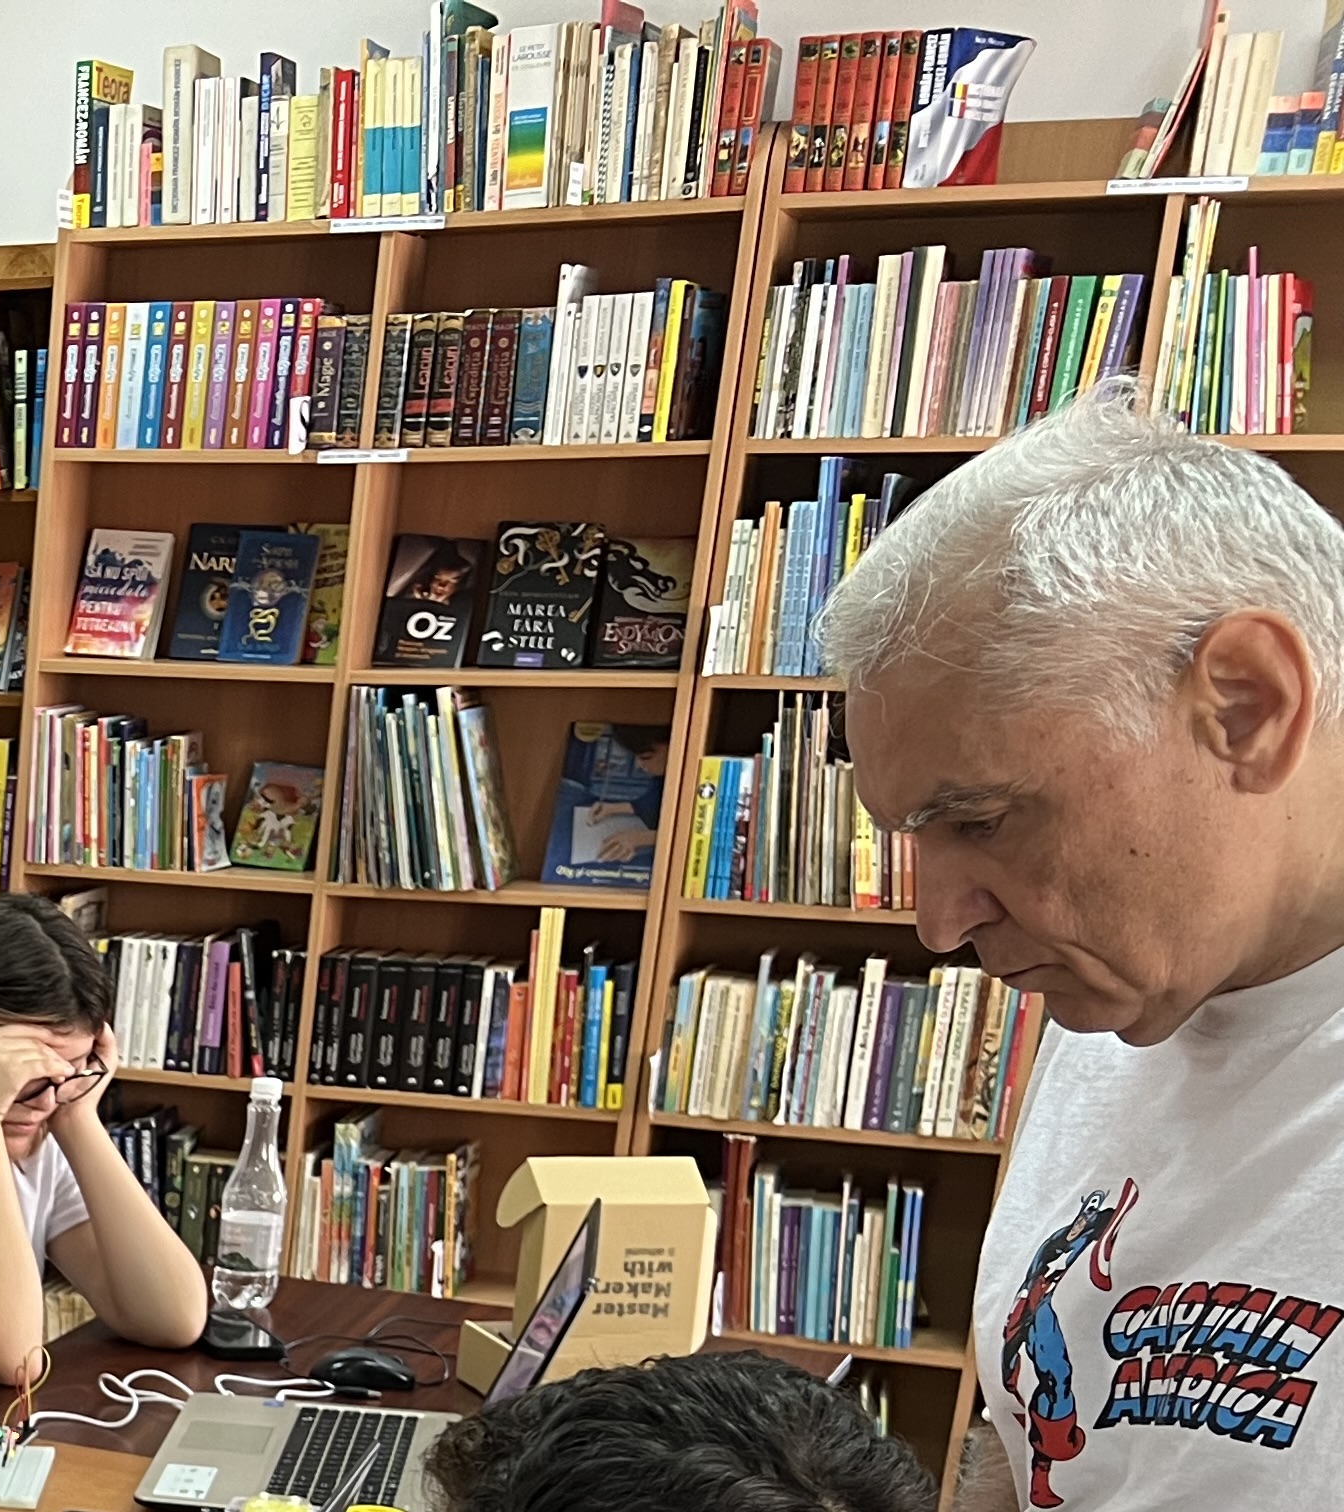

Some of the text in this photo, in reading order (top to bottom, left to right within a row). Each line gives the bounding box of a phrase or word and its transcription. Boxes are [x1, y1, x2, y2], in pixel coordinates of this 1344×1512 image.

[95, 66, 132, 102] Teora
[623, 1260, 673, 1279] with
[592, 1303, 669, 1318] Master
[1103, 1281, 1344, 1373] CAPTAIN
